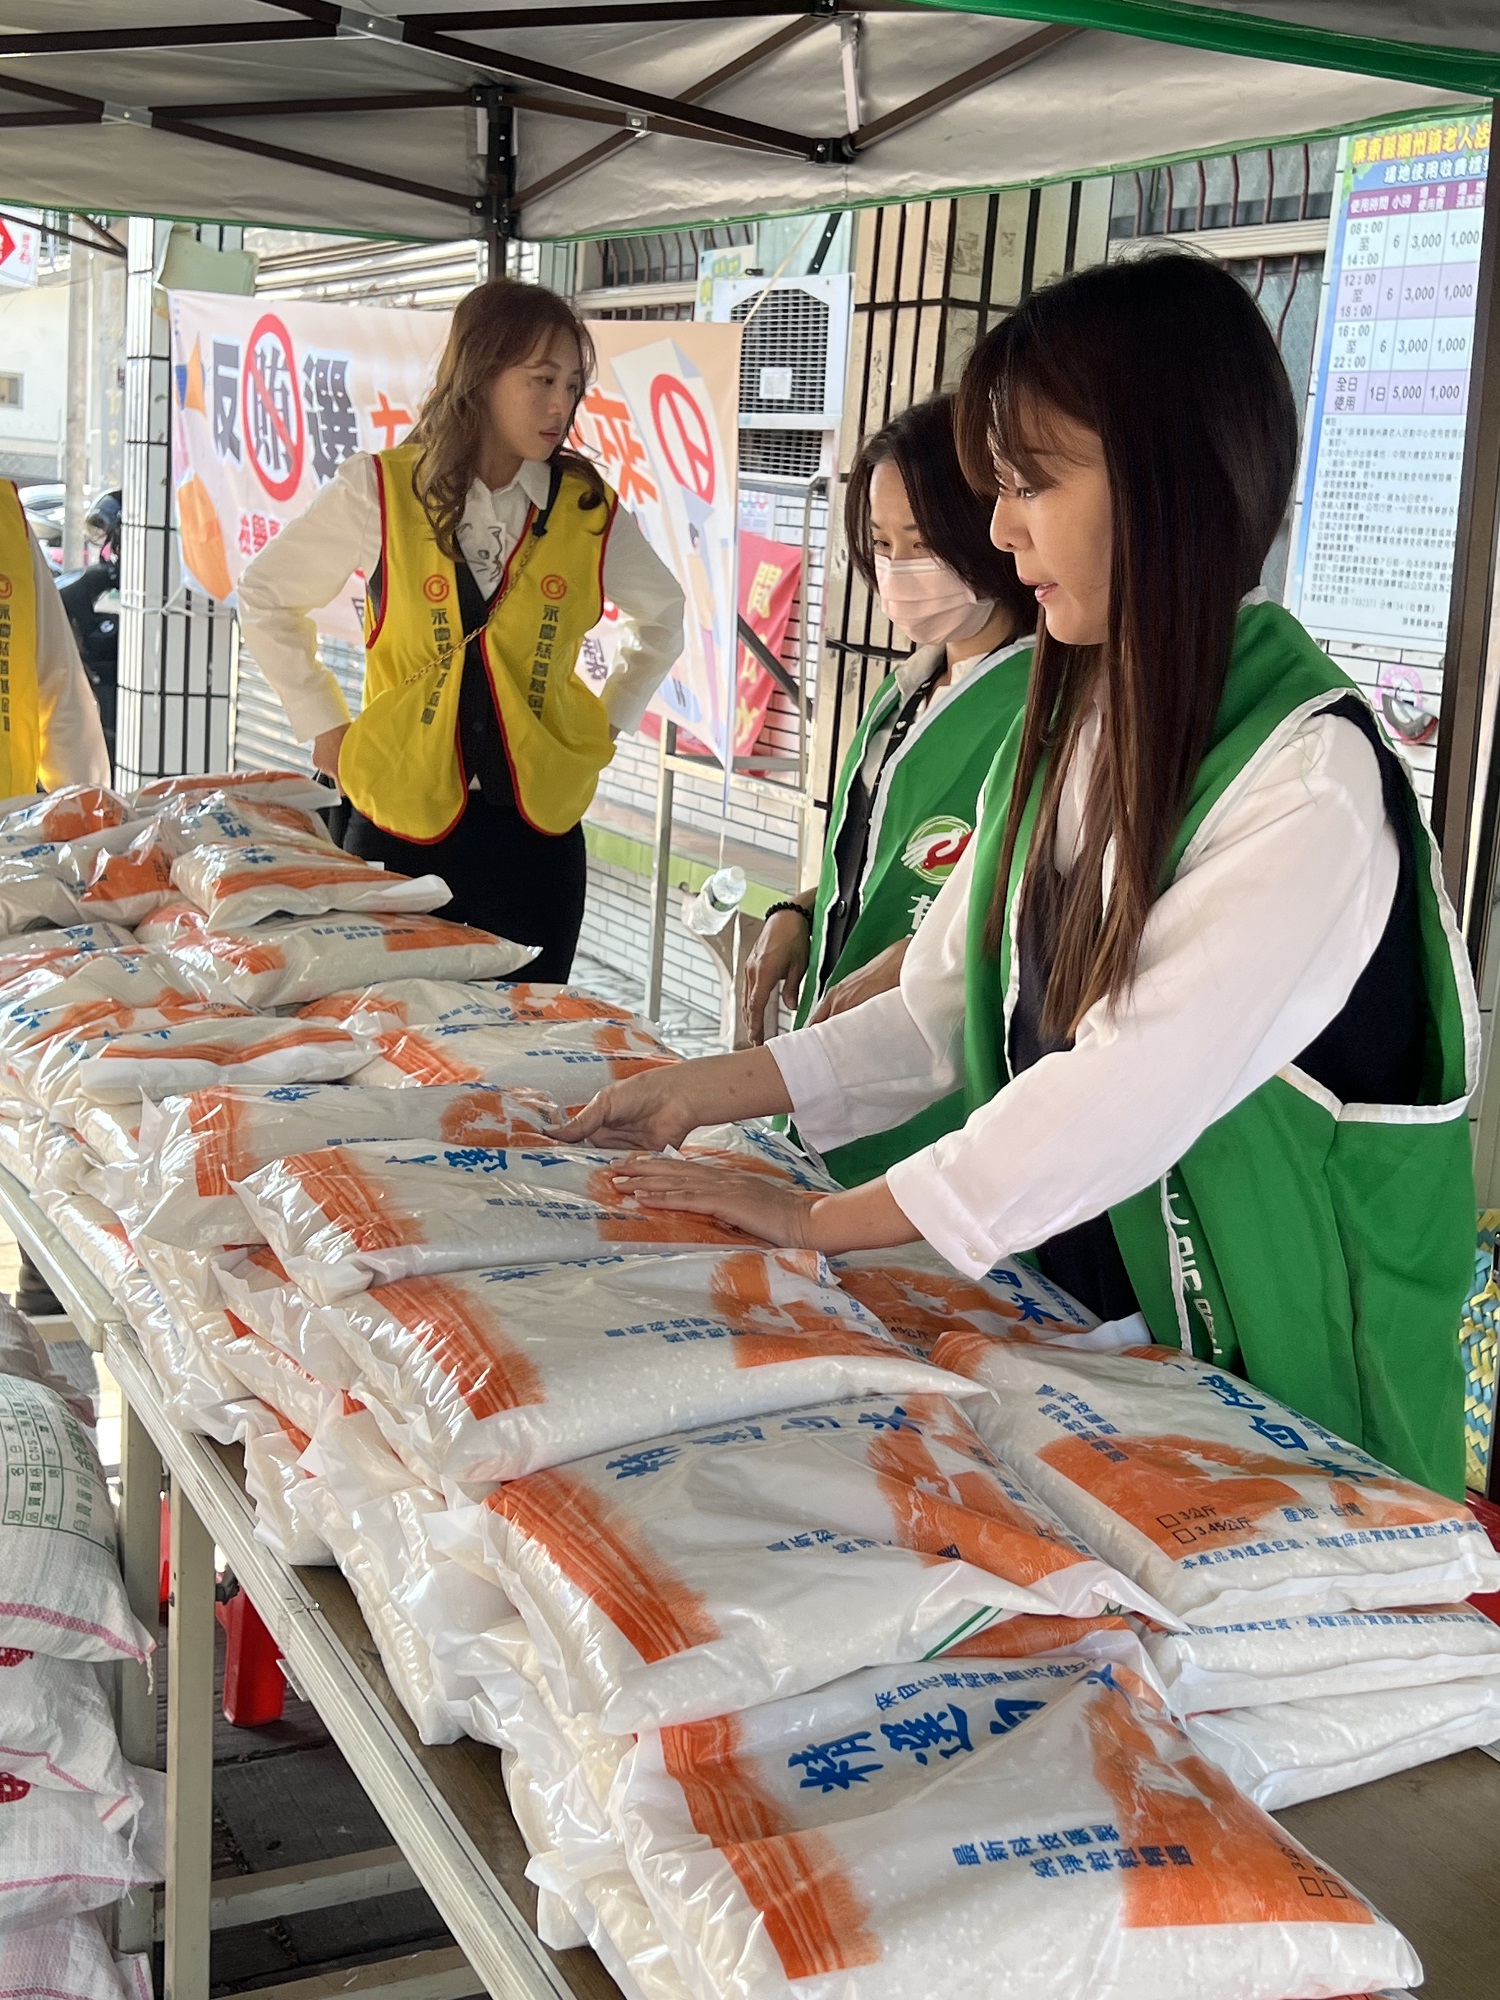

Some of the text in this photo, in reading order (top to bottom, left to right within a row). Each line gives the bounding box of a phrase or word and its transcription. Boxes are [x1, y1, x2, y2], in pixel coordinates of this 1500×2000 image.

[1393, 235, 1400, 248] 6
[1411, 234, 1442, 249] 3,000
[1451, 230, 1479, 247] 1,000
[1386, 288, 1393, 301] 6
[1404, 286, 1435, 302] 3,000
[1444, 285, 1472, 299] 1,000
[1380, 341, 1387, 353] 6
[1398, 339, 1428, 354] 3,000
[1437, 338, 1465, 353] 1,000
[1336, 377, 1358, 392] 全日
[1370, 386, 1386, 401] 1日
[1392, 385, 1422, 400] 5,000
[1431, 385, 1460, 401] 1,000
[1182, 1504, 1217, 1521] 3公斤
[1198, 1517, 1253, 1537] 3.45公斤
[952, 1823, 1120, 1867] 最新科技碾製
[1030, 1844, 1194, 1878] 純淨粒粒精選
